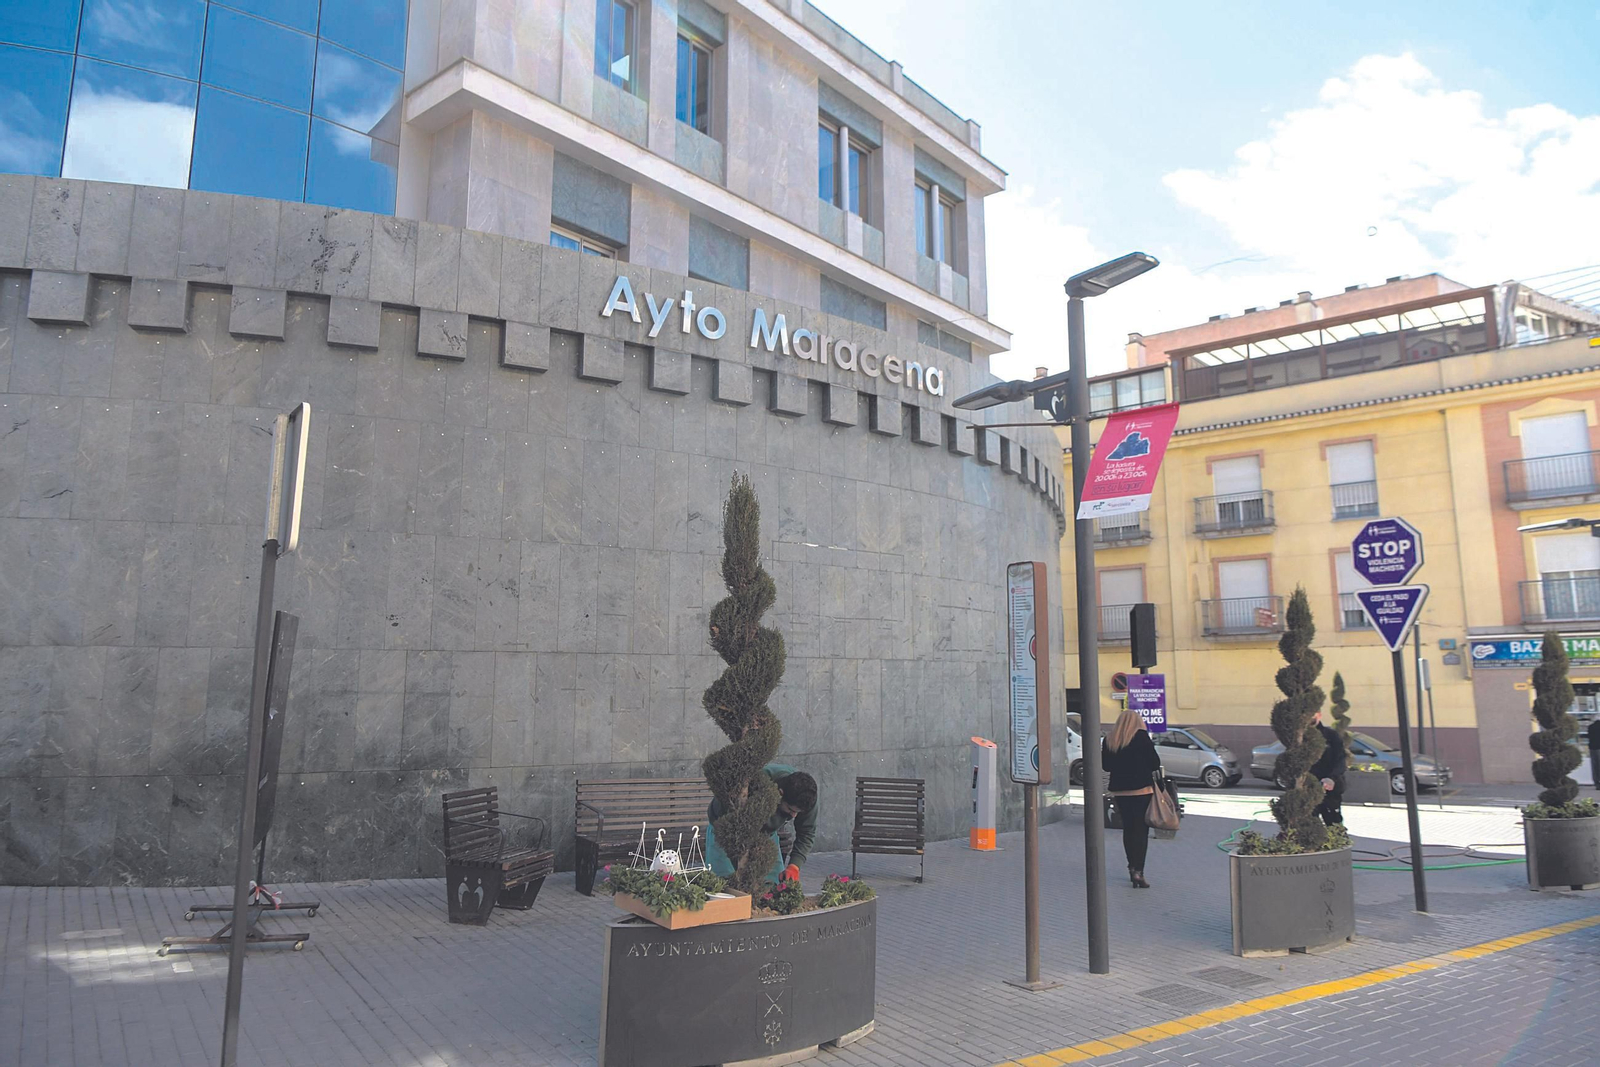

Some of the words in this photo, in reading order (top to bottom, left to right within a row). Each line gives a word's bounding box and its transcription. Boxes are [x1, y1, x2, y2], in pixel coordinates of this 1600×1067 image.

[601, 275, 727, 340] Ayto
[750, 307, 944, 397] Maracena
[1358, 540, 1411, 558] STOP
[1367, 558, 1405, 566] VIOLENCIA
[1510, 641, 1569, 653] BAZR
[1150, 708, 1162, 716] ME
[1142, 716, 1164, 724] PLICO
[627, 932, 782, 958] AYUNTAMIENTO
[790, 929, 808, 946] DE
[816, 915, 873, 942] MARACENA
